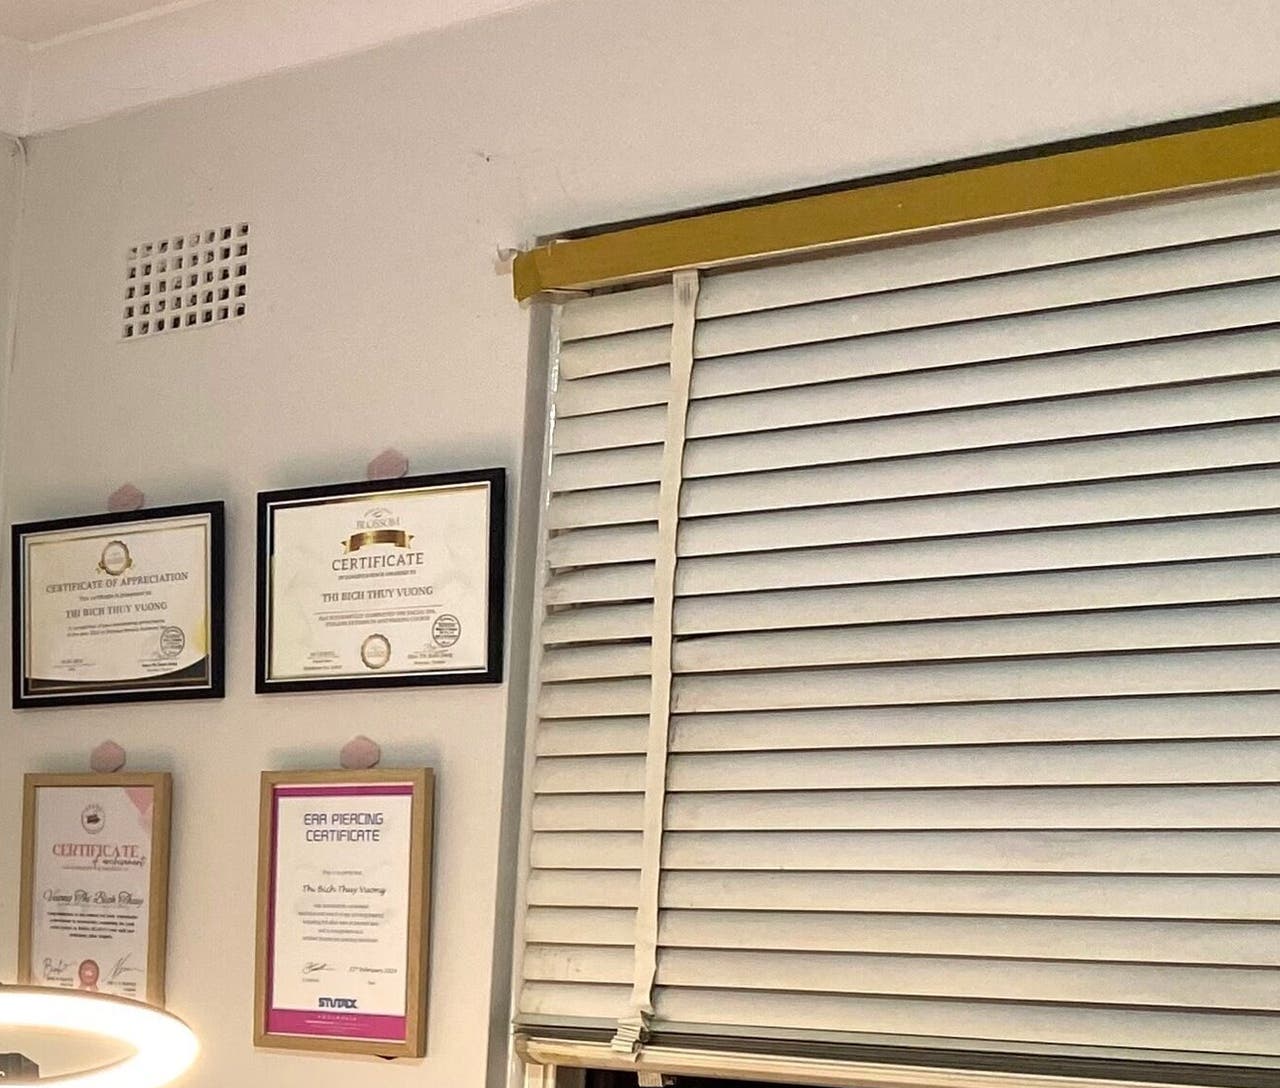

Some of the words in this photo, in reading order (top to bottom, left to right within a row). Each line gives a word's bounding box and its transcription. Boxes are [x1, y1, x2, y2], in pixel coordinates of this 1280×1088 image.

[332, 552, 424, 571] CERTIFICATE
[46, 580, 103, 593] CERTIFICATE
[105, 578, 118, 588] OF
[120, 572, 189, 587] APPRECIATION
[303, 813, 327, 826] EAR
[331, 812, 384, 826] PIERCING
[305, 829, 380, 842] CERTIFICATE
[52, 843, 140, 858] CERTIFICATE
